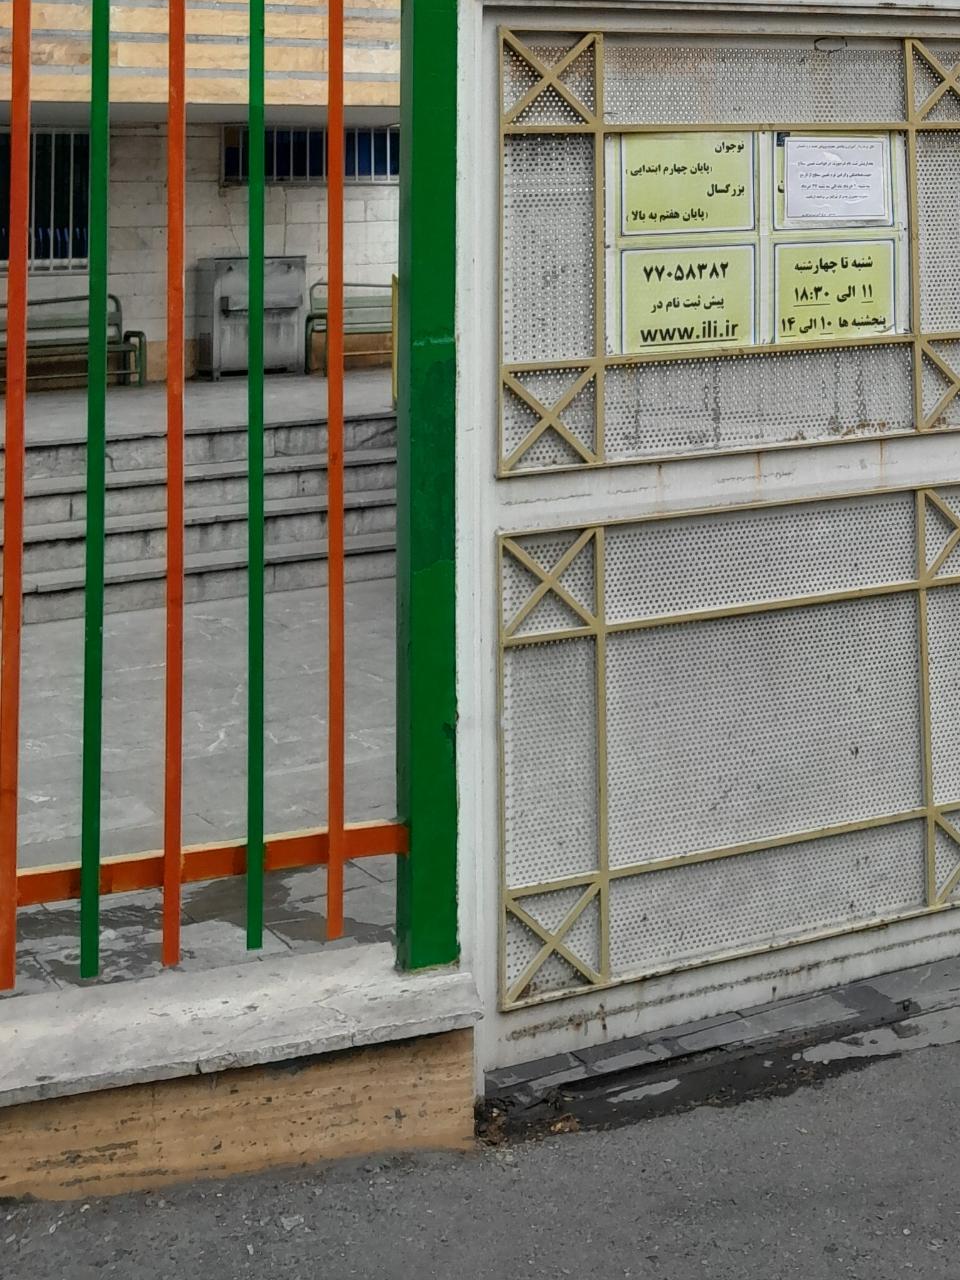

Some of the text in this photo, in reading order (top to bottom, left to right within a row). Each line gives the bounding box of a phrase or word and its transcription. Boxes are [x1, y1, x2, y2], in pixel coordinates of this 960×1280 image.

[714, 140, 745, 153] نوجوان
[663, 163, 688, 176] چهارم
[706, 183, 745, 197] بزرگسال
[648, 211, 657, 223] به
[659, 209, 680, 223] هفتم
[643, 261, 729, 283] ۷۷۰۵۸۳۸۲
[794, 256, 874, 275] شنبه تا چهارشنبه
[836, 284, 856, 303] الی
[862, 283, 873, 298] ۱۱
[650, 294, 725, 313] پیش ثبت نام در
[799, 317, 817, 334] الی
[838, 316, 849, 328] ها
[640, 319, 739, 343] www.ili.ir
